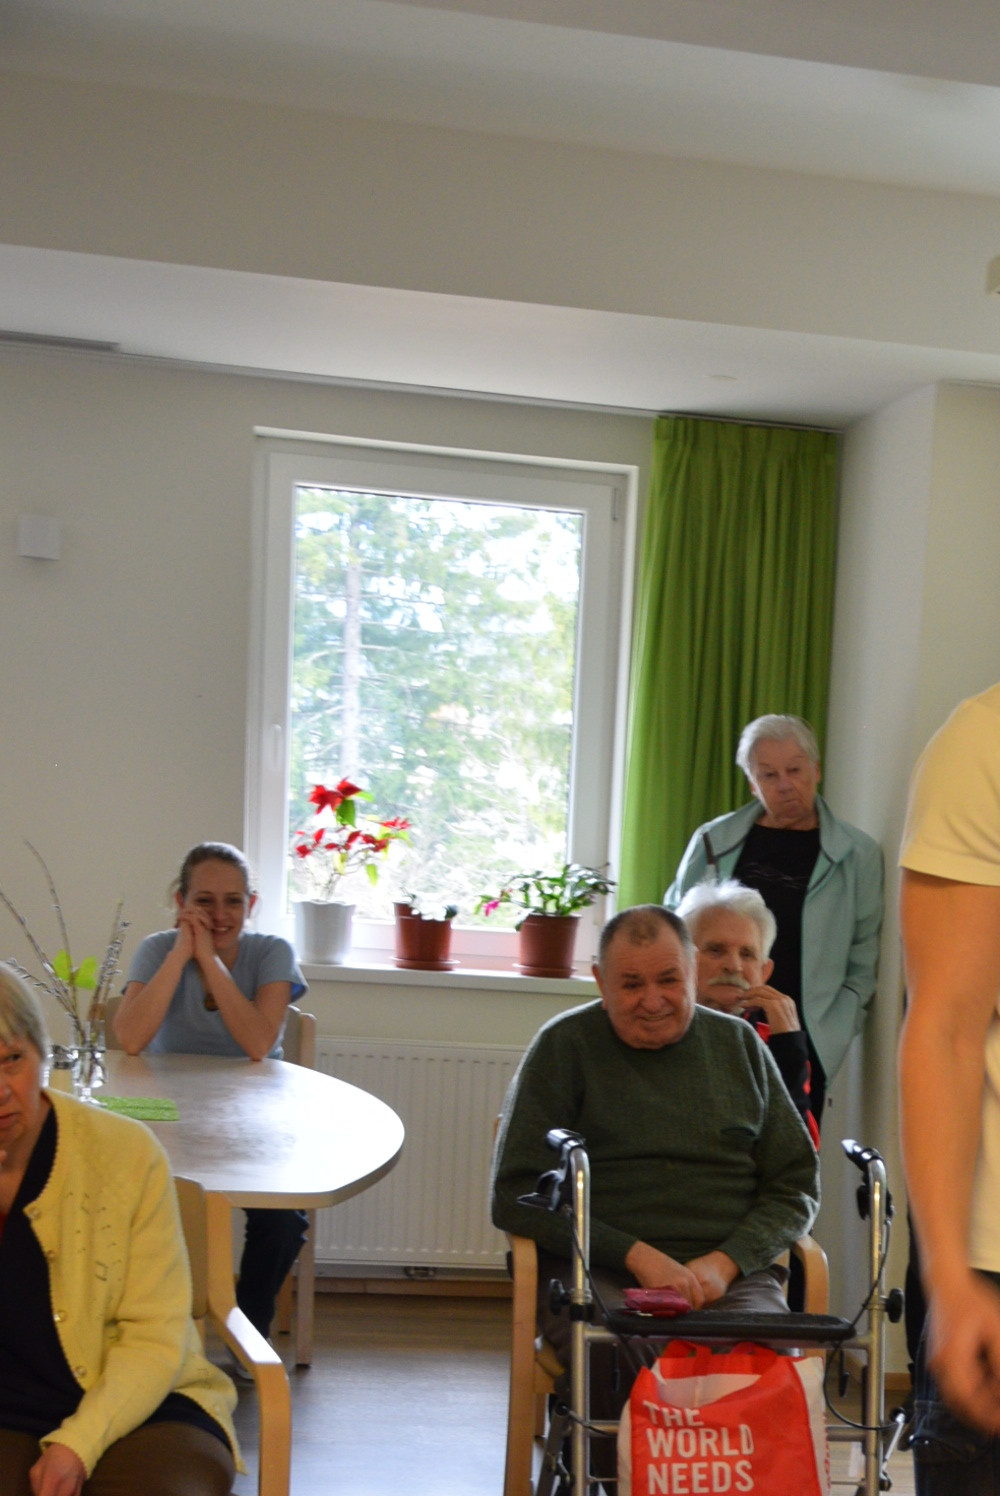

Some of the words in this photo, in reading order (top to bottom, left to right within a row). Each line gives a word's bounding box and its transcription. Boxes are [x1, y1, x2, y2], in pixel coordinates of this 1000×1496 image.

[643, 1400, 704, 1428] THE
[646, 1424, 755, 1458] WORLD
[648, 1460, 755, 1495] NEEDS
